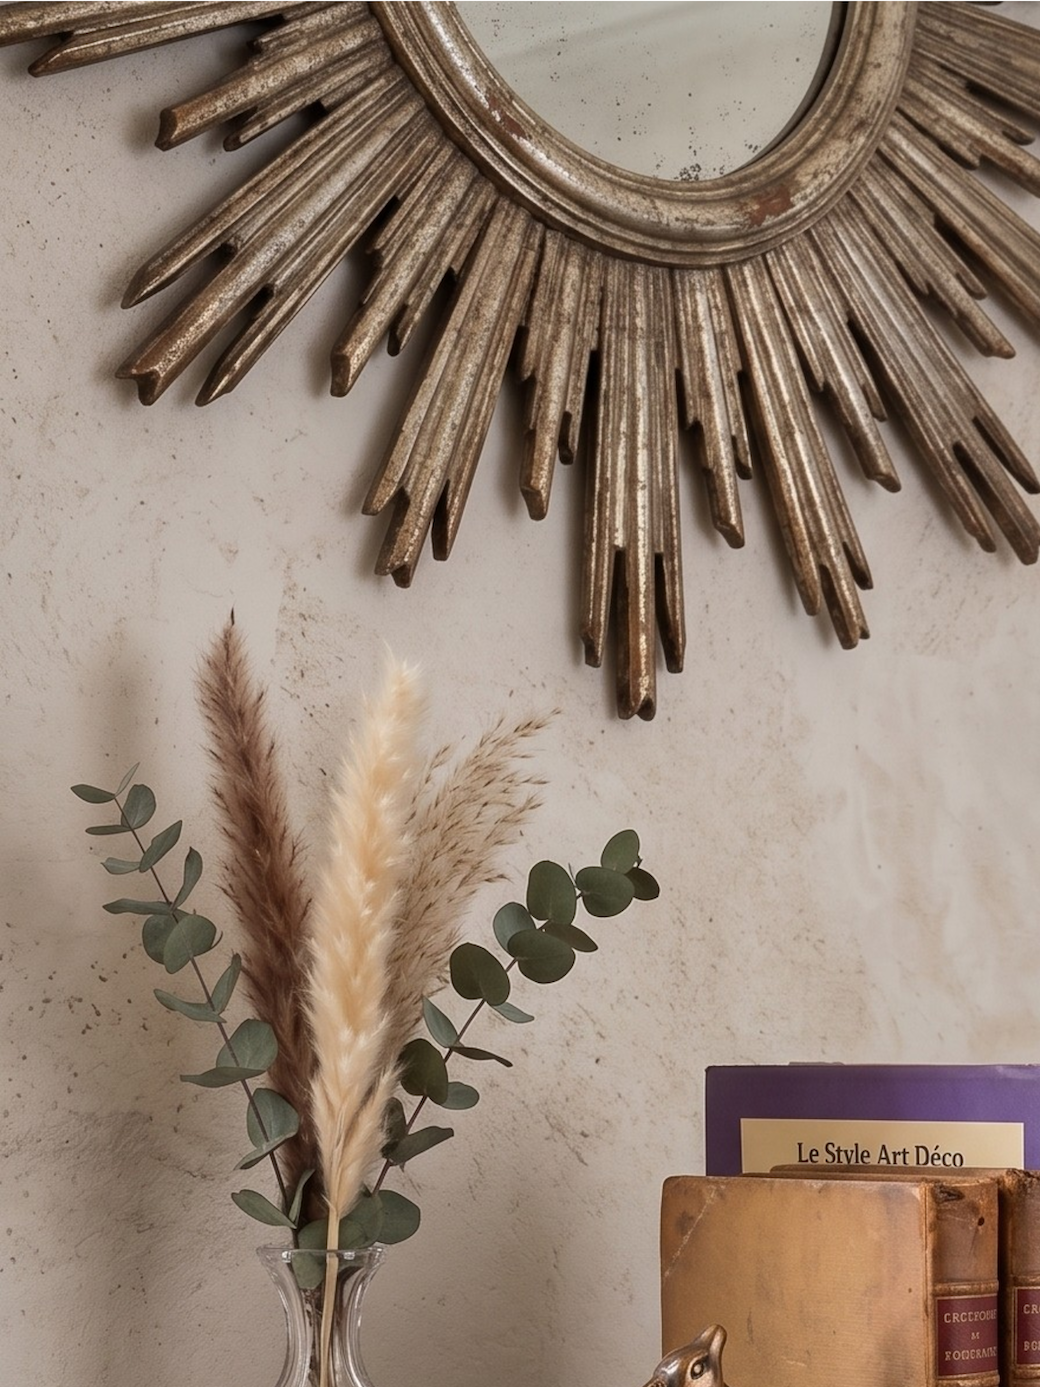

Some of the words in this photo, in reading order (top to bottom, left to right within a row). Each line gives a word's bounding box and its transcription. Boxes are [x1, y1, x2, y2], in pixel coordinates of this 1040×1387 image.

[797, 1142, 819, 1163] Le
[825, 1142, 871, 1165] Style
[877, 1144, 909, 1166] Art
[915, 1145, 964, 1168] Déco
